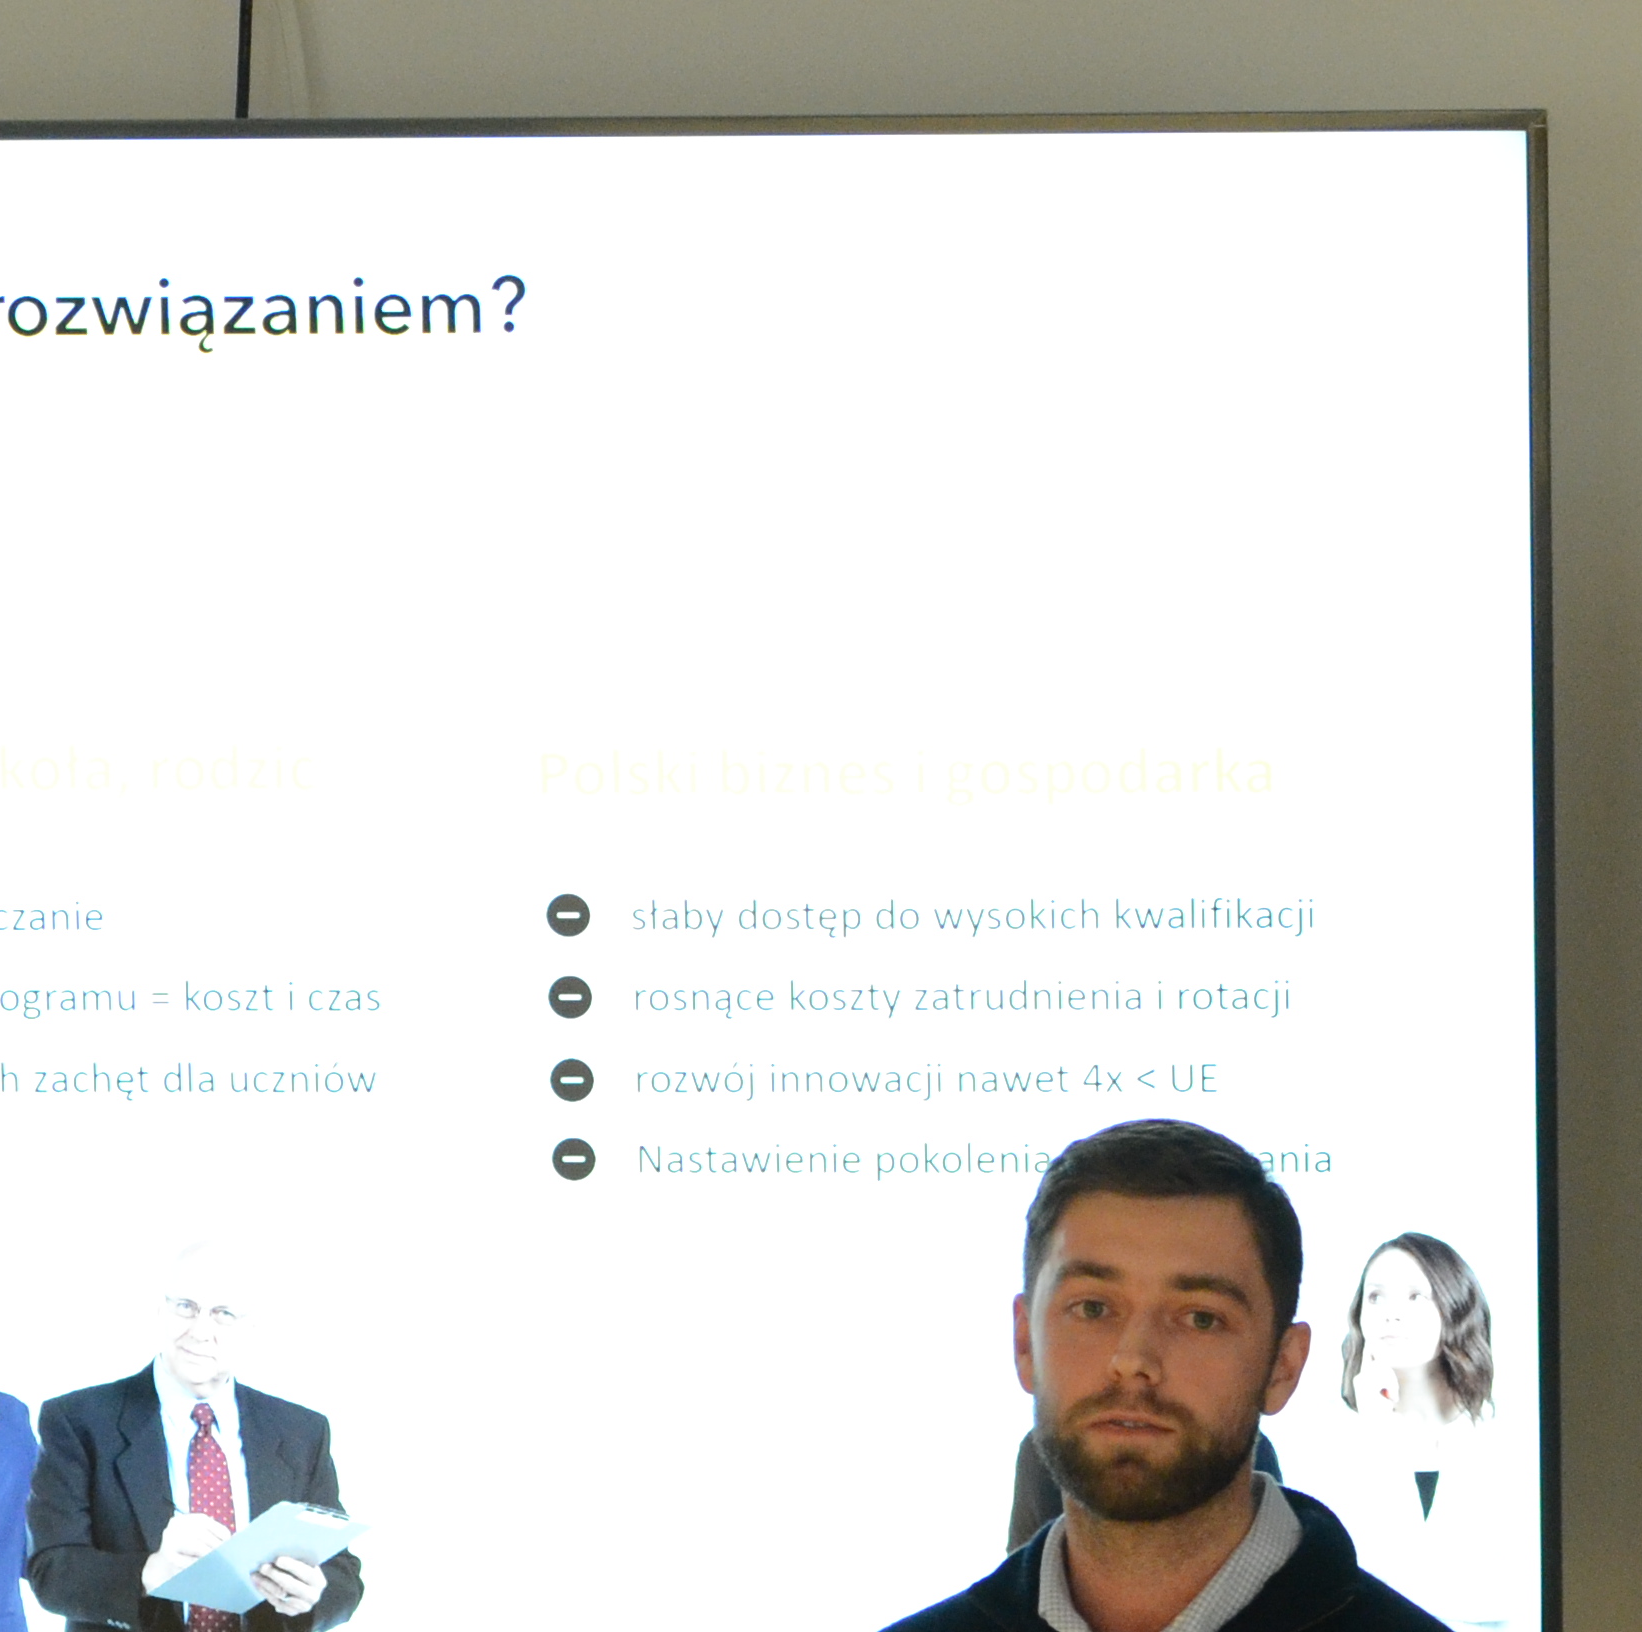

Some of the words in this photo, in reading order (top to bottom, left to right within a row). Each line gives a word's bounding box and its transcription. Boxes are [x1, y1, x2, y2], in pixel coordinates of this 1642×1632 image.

[151, 746, 314, 790] rodzic
[540, 749, 696, 795] Polski
[722, 749, 894, 795] biznes
[917, 750, 925, 793] i
[947, 748, 1272, 805] gospodarka
[632, 898, 724, 939] słaby
[738, 898, 862, 939] dostęp
[875, 898, 920, 930] do
[933, 897, 1100, 938] wysokich
[1115, 897, 1314, 938] kwalifikacji
[151, 992, 170, 1005] =
[185, 980, 275, 1012] koszt
[288, 981, 294, 1011] i
[308, 989, 382, 1012] czas
[635, 988, 776, 1020] rosnące
[790, 980, 902, 1019] koszty
[914, 980, 1142, 1011] zatrudnienia
[1157, 980, 1164, 1010] i
[1178, 979, 1290, 1019] rotacji
[34, 1062, 150, 1102] zachęt
[163, 1062, 216, 1093] dla
[230, 1062, 378, 1094] uczniów
[636, 1061, 755, 1102] rozwój
[770, 1063, 942, 1102] innowacji
[958, 1065, 1070, 1093] nawet
[1082, 1063, 1124, 1093] 4x
[1136, 1068, 1156, 1089] <
[1171, 1063, 1218, 1093] UE
[638, 1143, 862, 1174] Nastawienie
[876, 1142, 1049, 1181] pokolenia
[1257, 1144, 1332, 1173] ania
